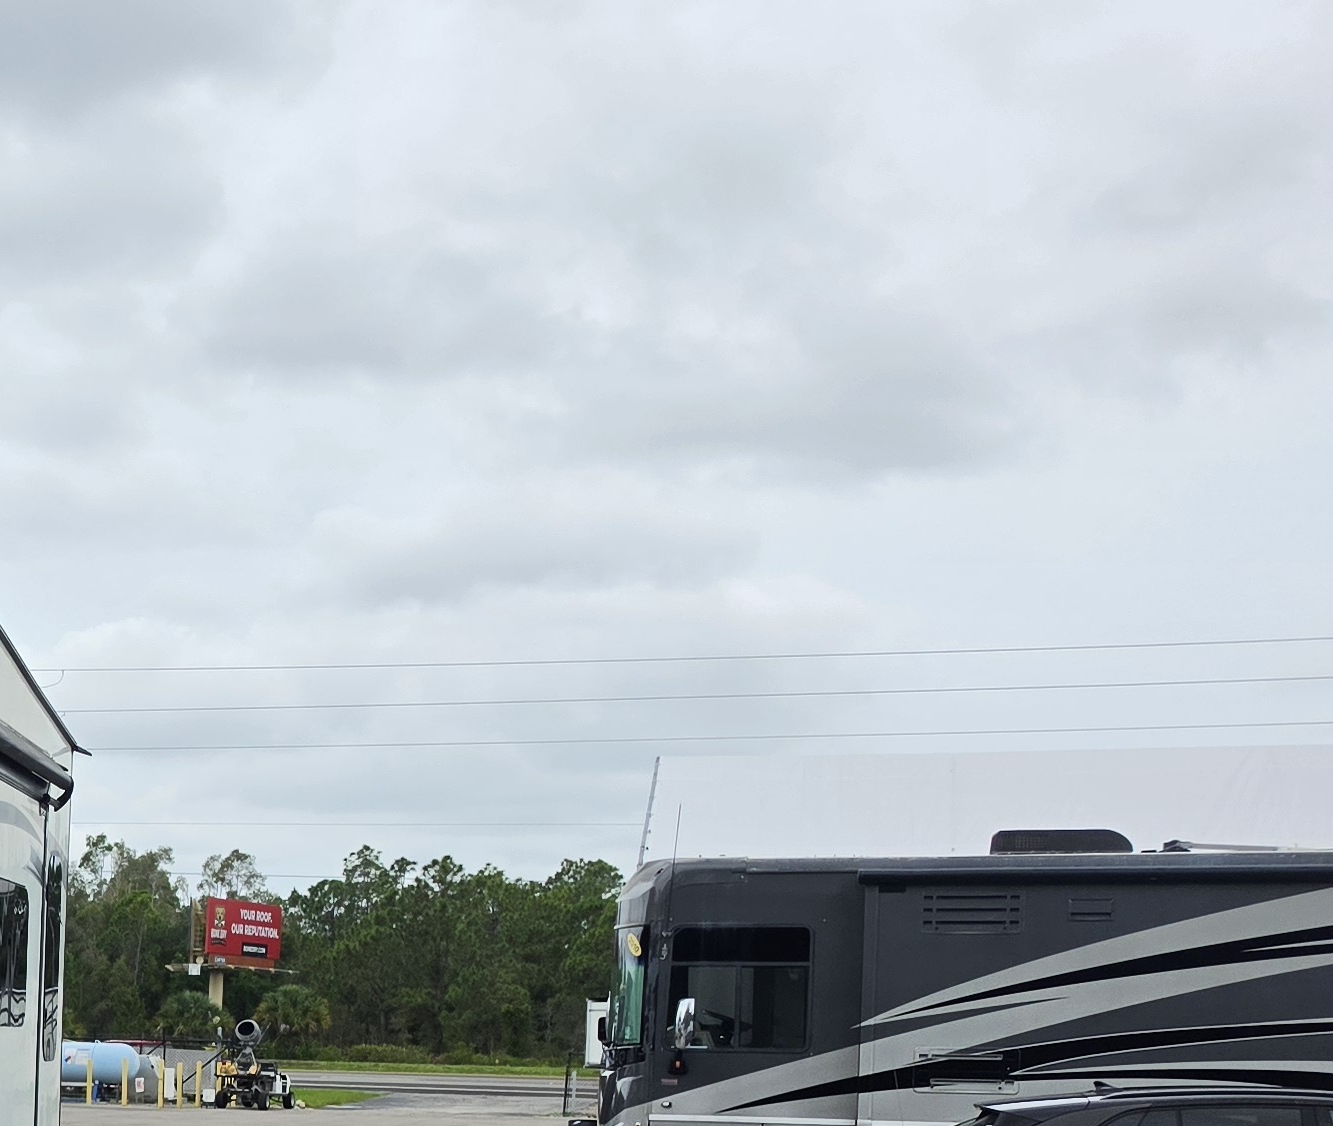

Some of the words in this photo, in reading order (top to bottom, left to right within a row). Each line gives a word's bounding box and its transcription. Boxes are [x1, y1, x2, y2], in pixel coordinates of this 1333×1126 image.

[239, 908, 255, 921] YOUR
[256, 910, 273, 923] ROOF.
[231, 922, 244, 935] OUR
[244, 924, 279, 939] REPUTATION.
